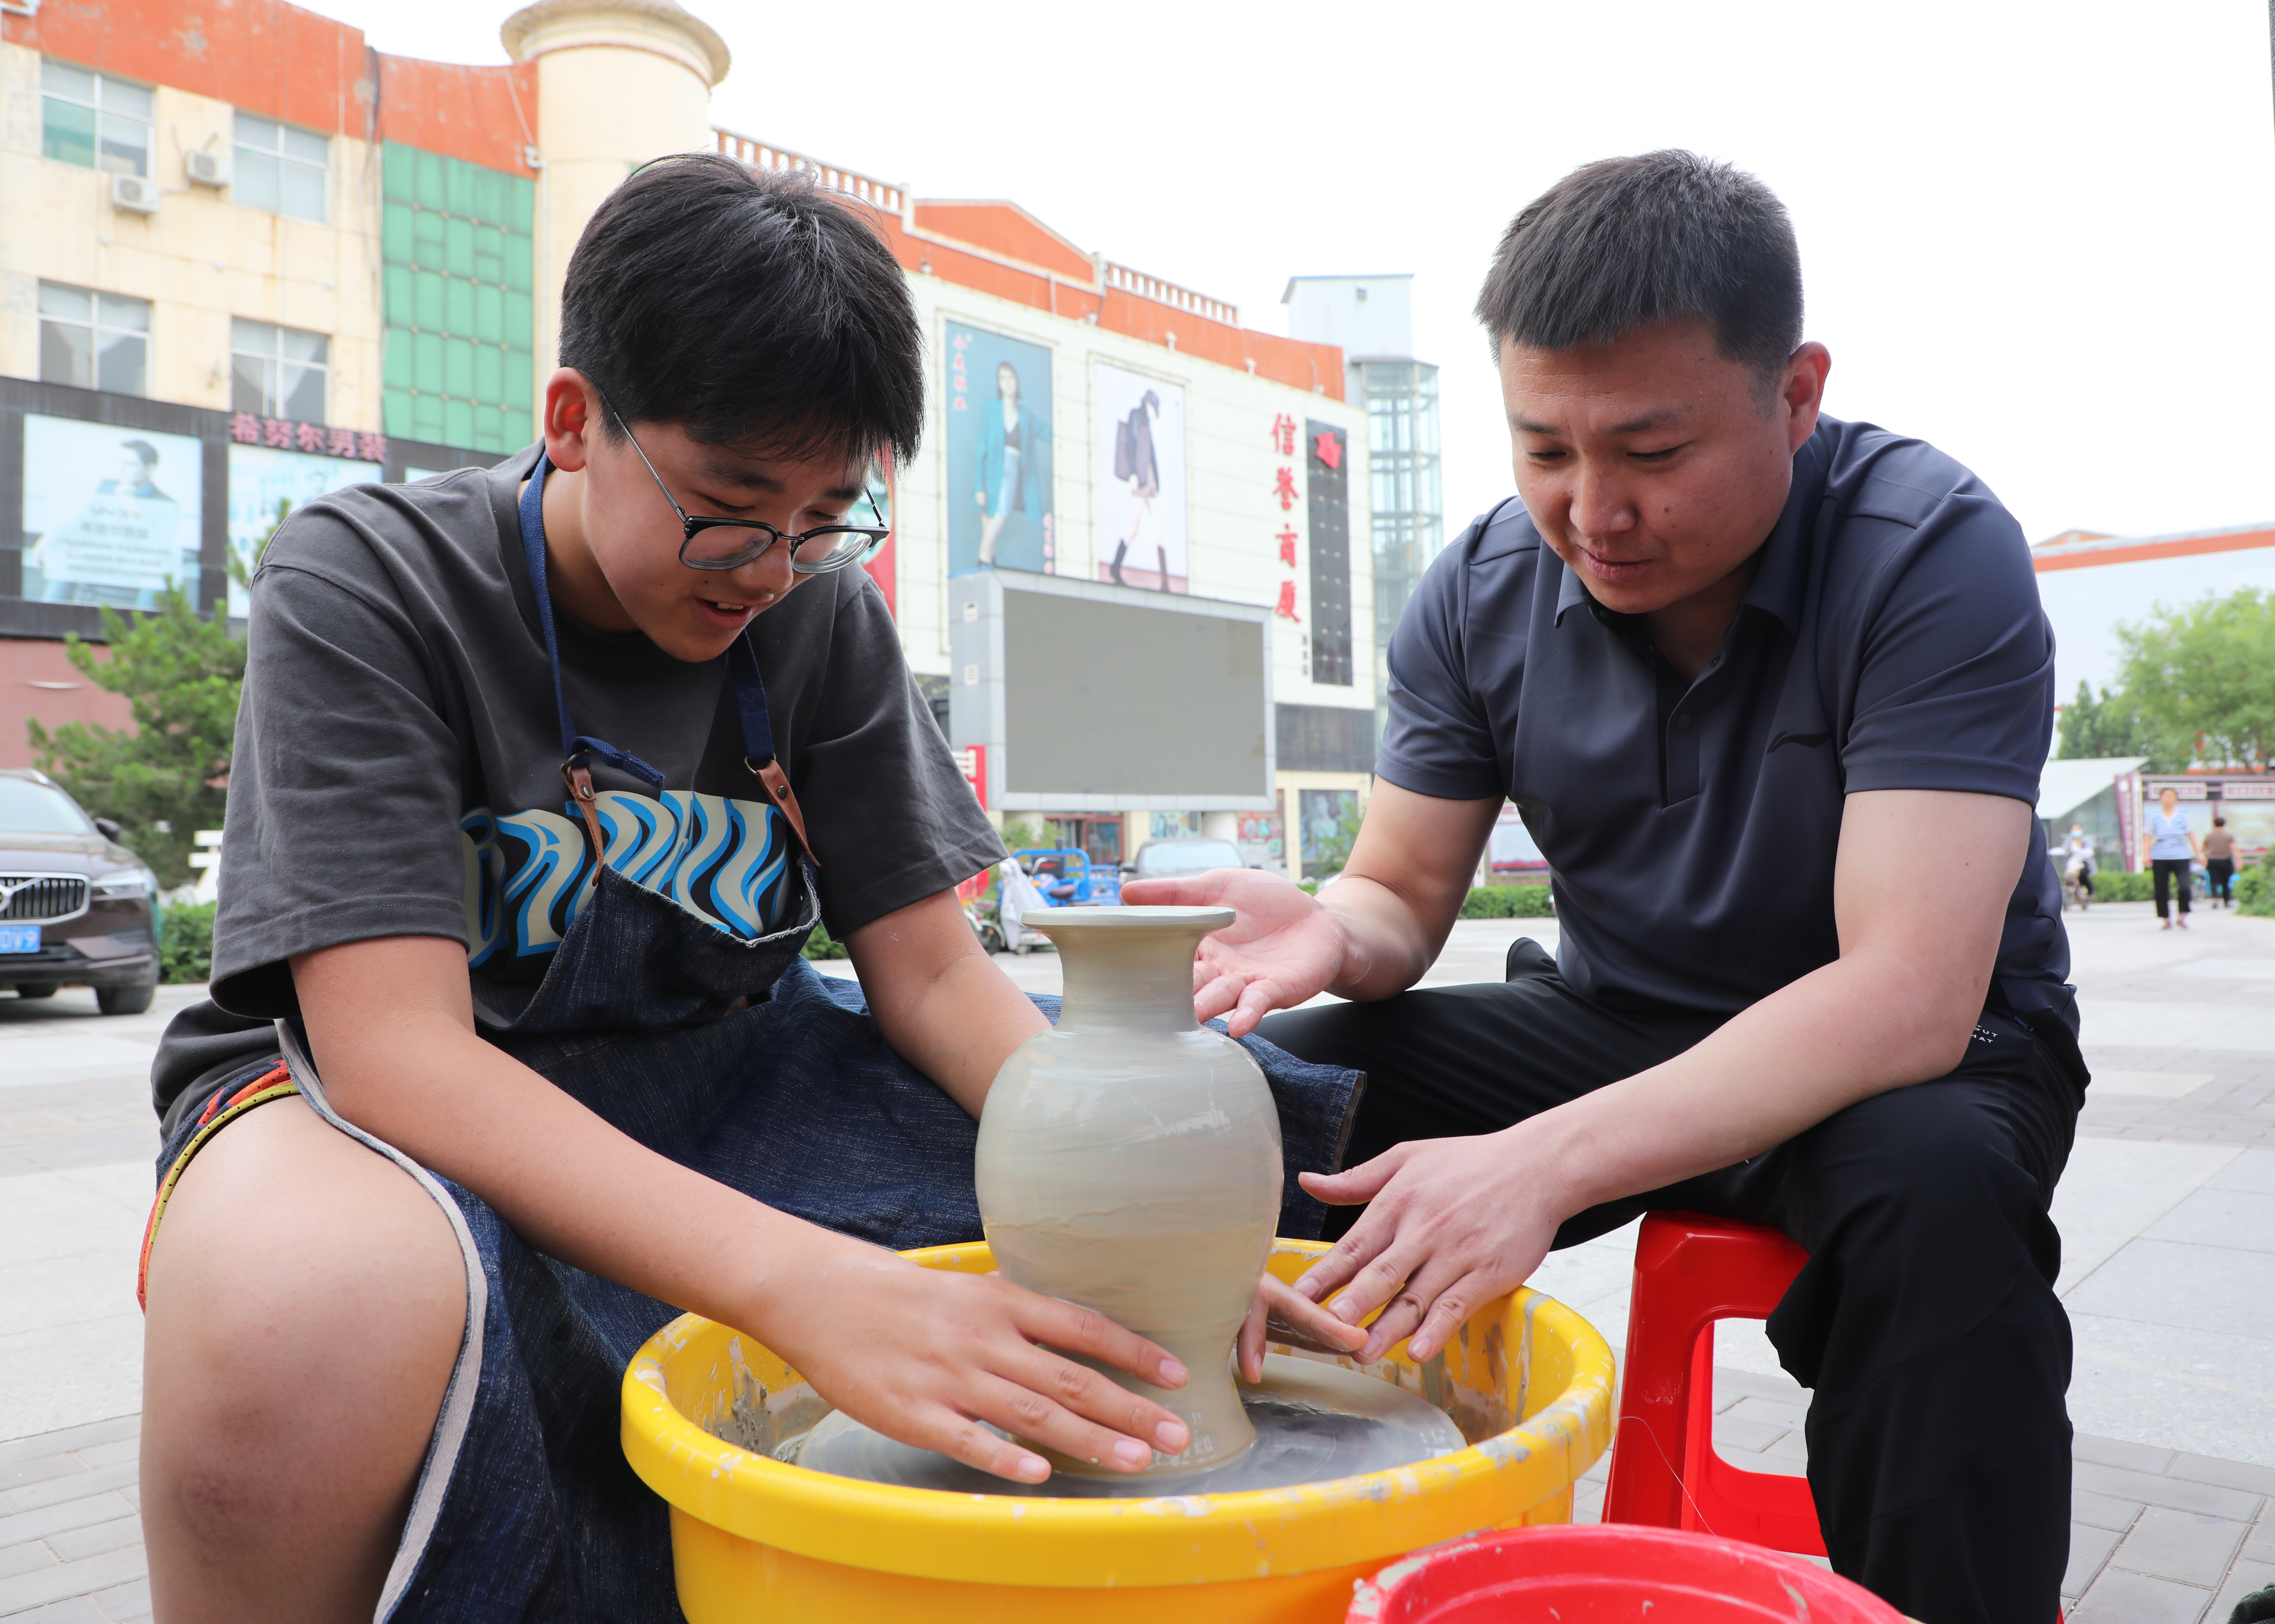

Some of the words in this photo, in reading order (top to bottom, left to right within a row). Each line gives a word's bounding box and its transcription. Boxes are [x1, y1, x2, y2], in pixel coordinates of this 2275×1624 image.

[230, 411, 387, 462] 希努尔男装
